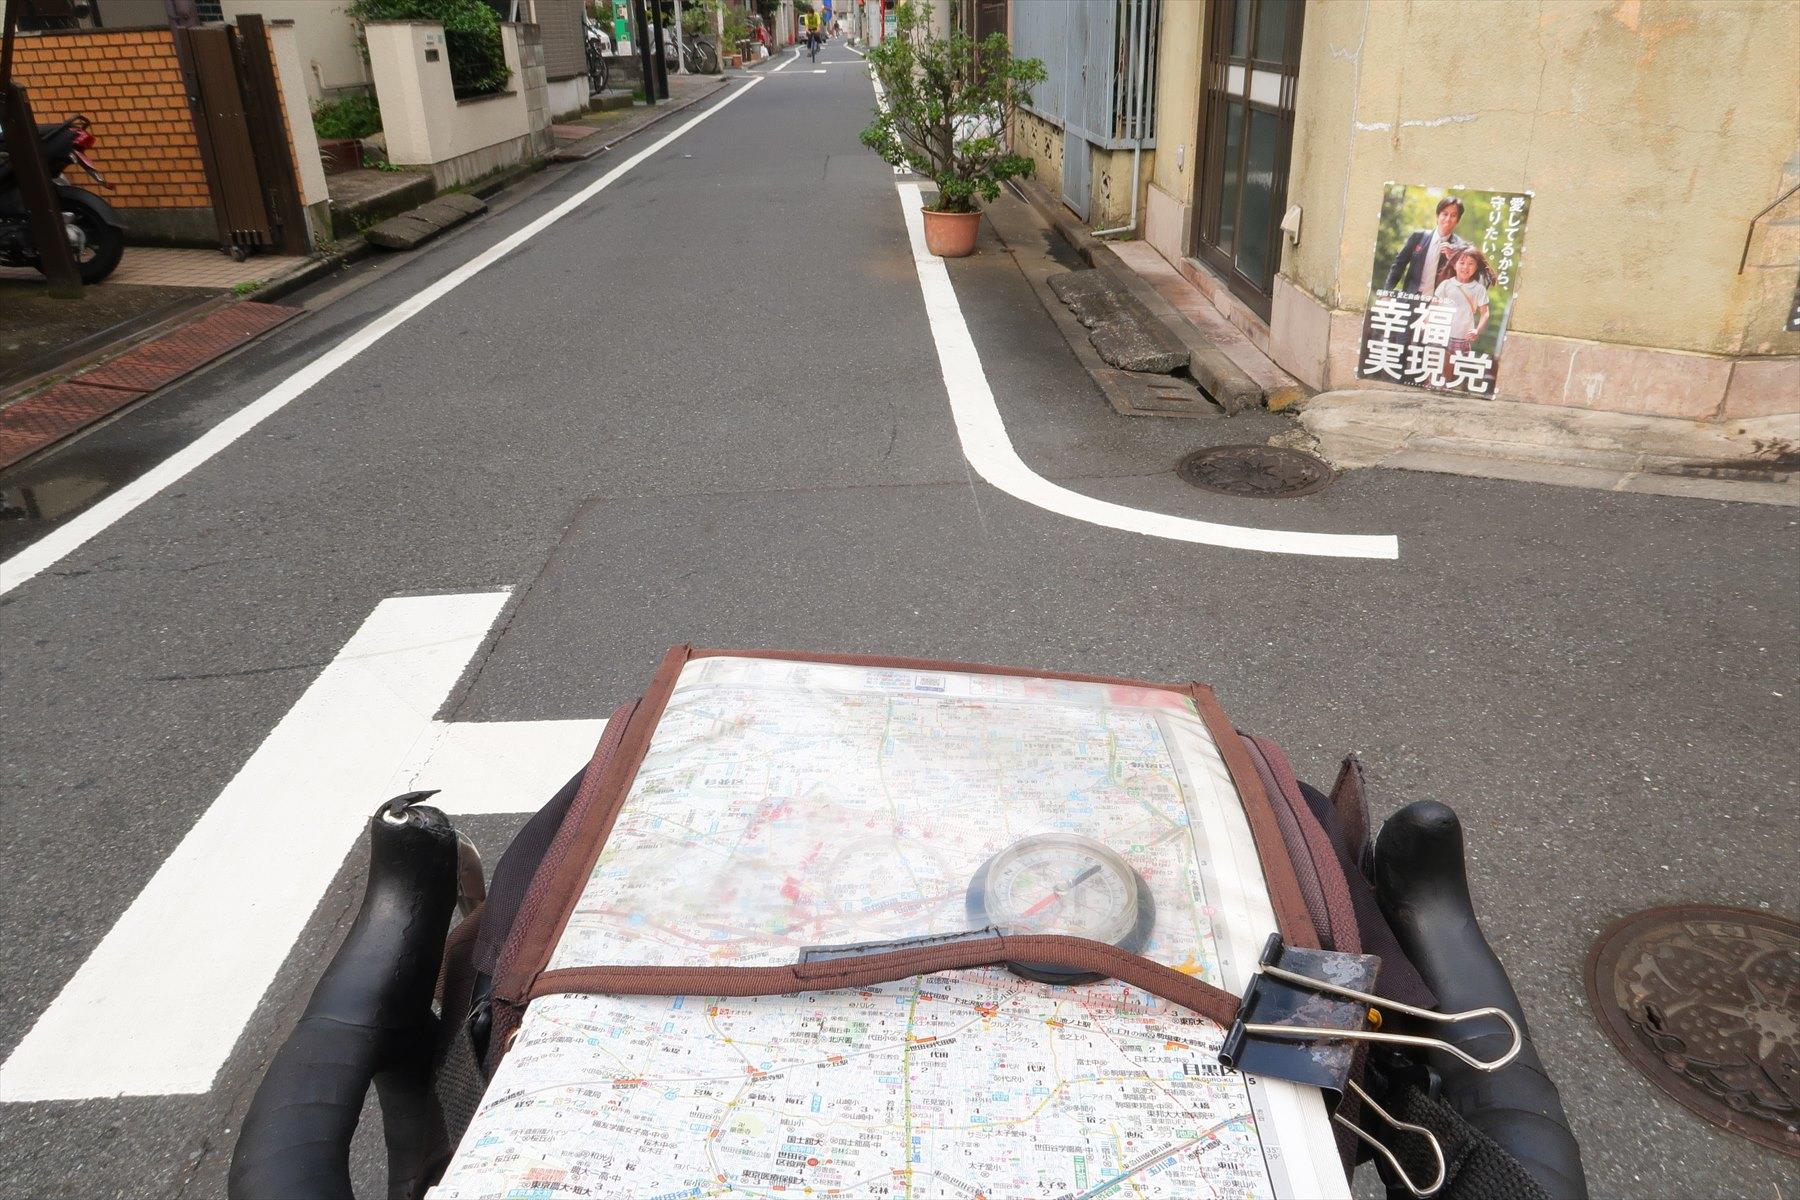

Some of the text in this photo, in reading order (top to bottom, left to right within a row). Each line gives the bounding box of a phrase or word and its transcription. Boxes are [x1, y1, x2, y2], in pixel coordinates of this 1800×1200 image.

[1482, 195, 1506, 261] 守りたい。
[1498, 197, 1525, 290] 愛してるから、
[1370, 298, 1457, 348] 幸福
[1363, 338, 1493, 393] 実現党
[1182, 1064, 1238, 1076] 目黒区
[778, 1152, 808, 1160] 世田谷
